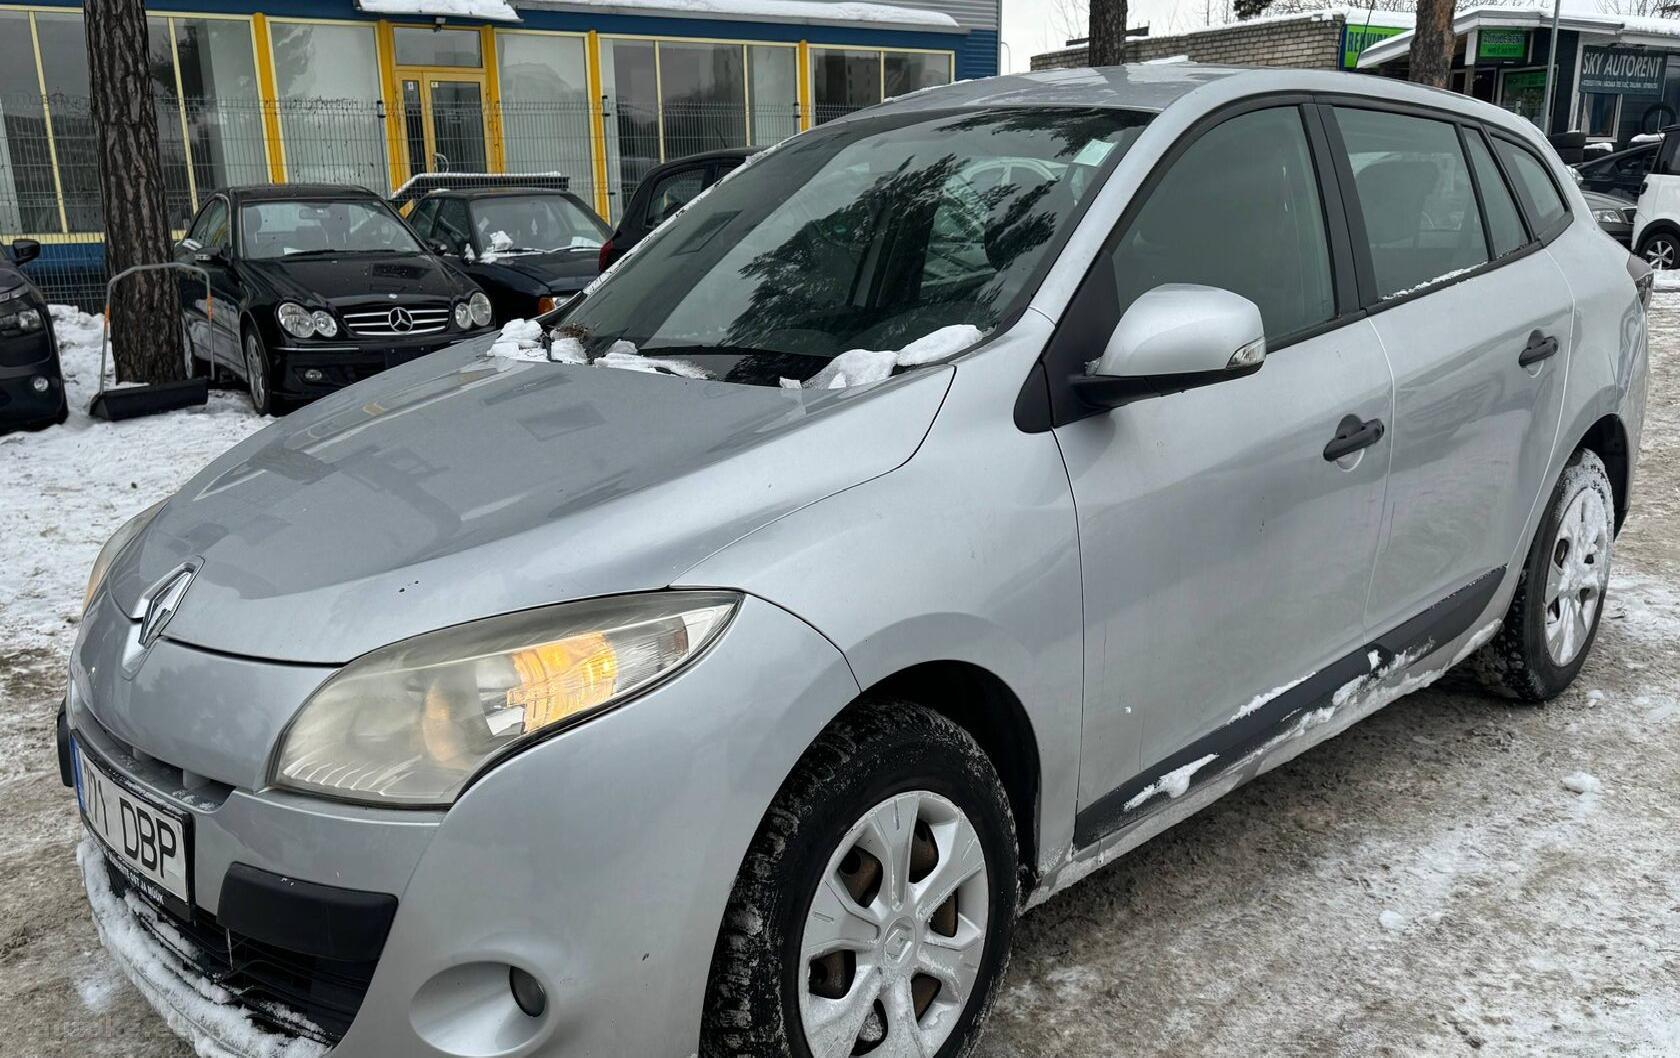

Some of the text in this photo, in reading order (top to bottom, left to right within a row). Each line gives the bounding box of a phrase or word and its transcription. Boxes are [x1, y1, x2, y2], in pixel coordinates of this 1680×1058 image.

[1583, 53, 1662, 78] SKY AUTORENT
[119, 796, 177, 880] DBP
